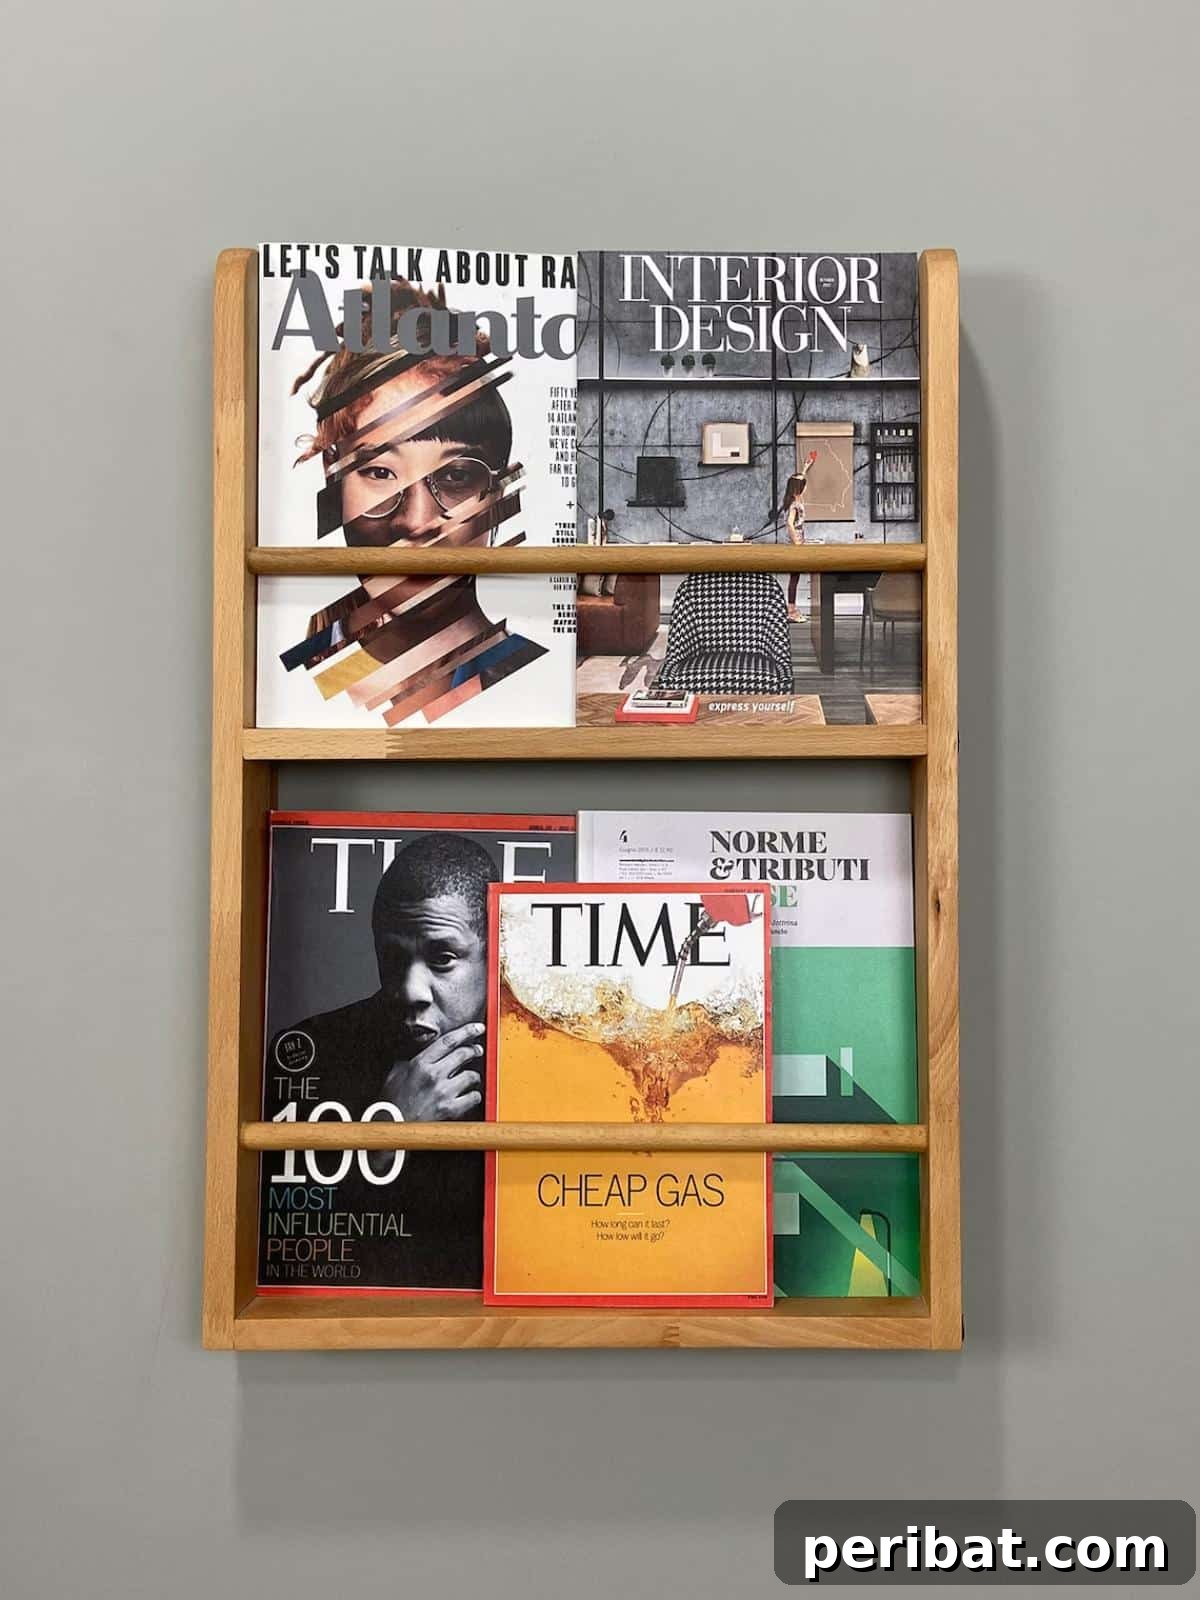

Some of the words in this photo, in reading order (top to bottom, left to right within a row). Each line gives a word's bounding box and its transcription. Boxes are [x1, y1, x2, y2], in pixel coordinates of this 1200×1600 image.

[264, 244, 340, 280] LET'S
[353, 246, 423, 282] TALK
[436, 250, 528, 288] ABOUT
[618, 254, 884, 304] INTERIOR
[650, 304, 852, 353] DESIGN
[709, 702, 750, 713] express
[752, 700, 797, 714] yourself
[709, 830, 827, 854] NORME
[311, 838, 552, 913] TE
[709, 857, 870, 881] &TRIBUTI
[531, 902, 731, 967] TIME
[273, 1077, 320, 1100] THE
[271, 1101, 406, 1185] 100
[269, 1186, 338, 1210] MOST
[537, 1173, 648, 1208] CHEAP
[656, 1173, 725, 1208] GAS
[268, 1212, 412, 1237] INFLUENTIAL
[592, 1219, 608, 1229] How
[610, 1219, 627, 1230] long
[628, 1220, 643, 1229] can
[645, 1219, 650, 1229] it
[651, 1219, 671, 1229] last?
[596, 1231, 613, 1240] How
[616, 1231, 629, 1240] low
[630, 1231, 642, 1240] will
[644, 1231, 649, 1240] it
[650, 1231, 665, 1243] go?
[267, 1238, 356, 1262] PEOPLE
[266, 1264, 280, 1278] IN
[284, 1264, 309, 1278] THE
[312, 1264, 361, 1279] WORLD
